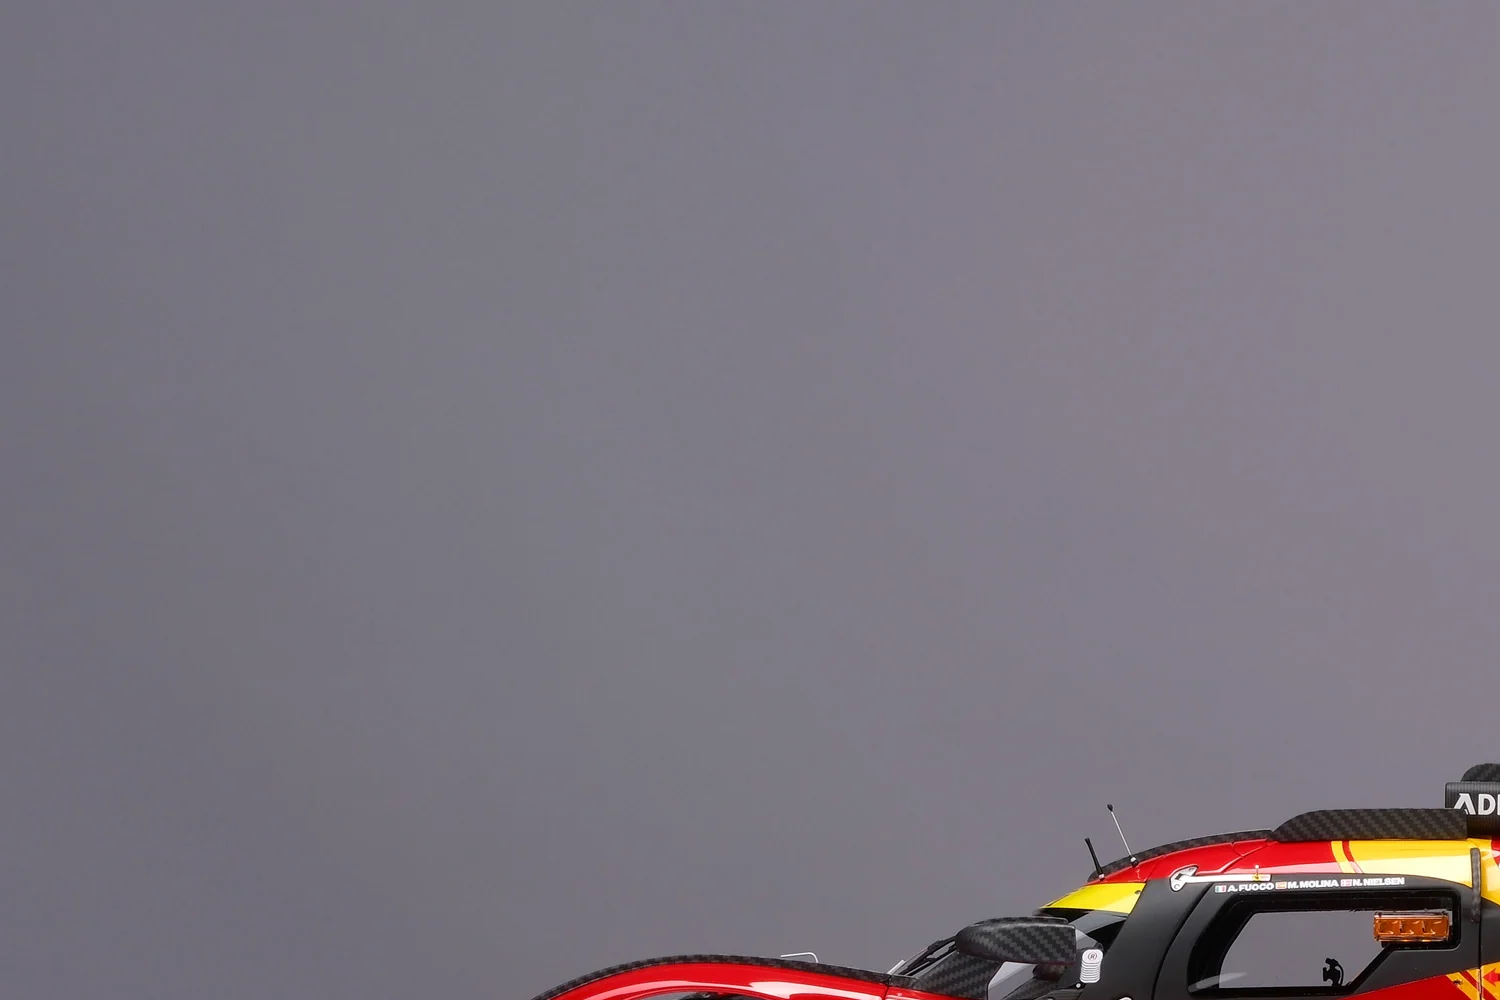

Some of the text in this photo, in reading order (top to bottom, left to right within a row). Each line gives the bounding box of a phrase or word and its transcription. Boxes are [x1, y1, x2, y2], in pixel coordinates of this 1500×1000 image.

[1239, 882, 1275, 892] FUOCO
[1300, 879, 1340, 889] MOLINA
[1363, 877, 1405, 887] NIELSEN
